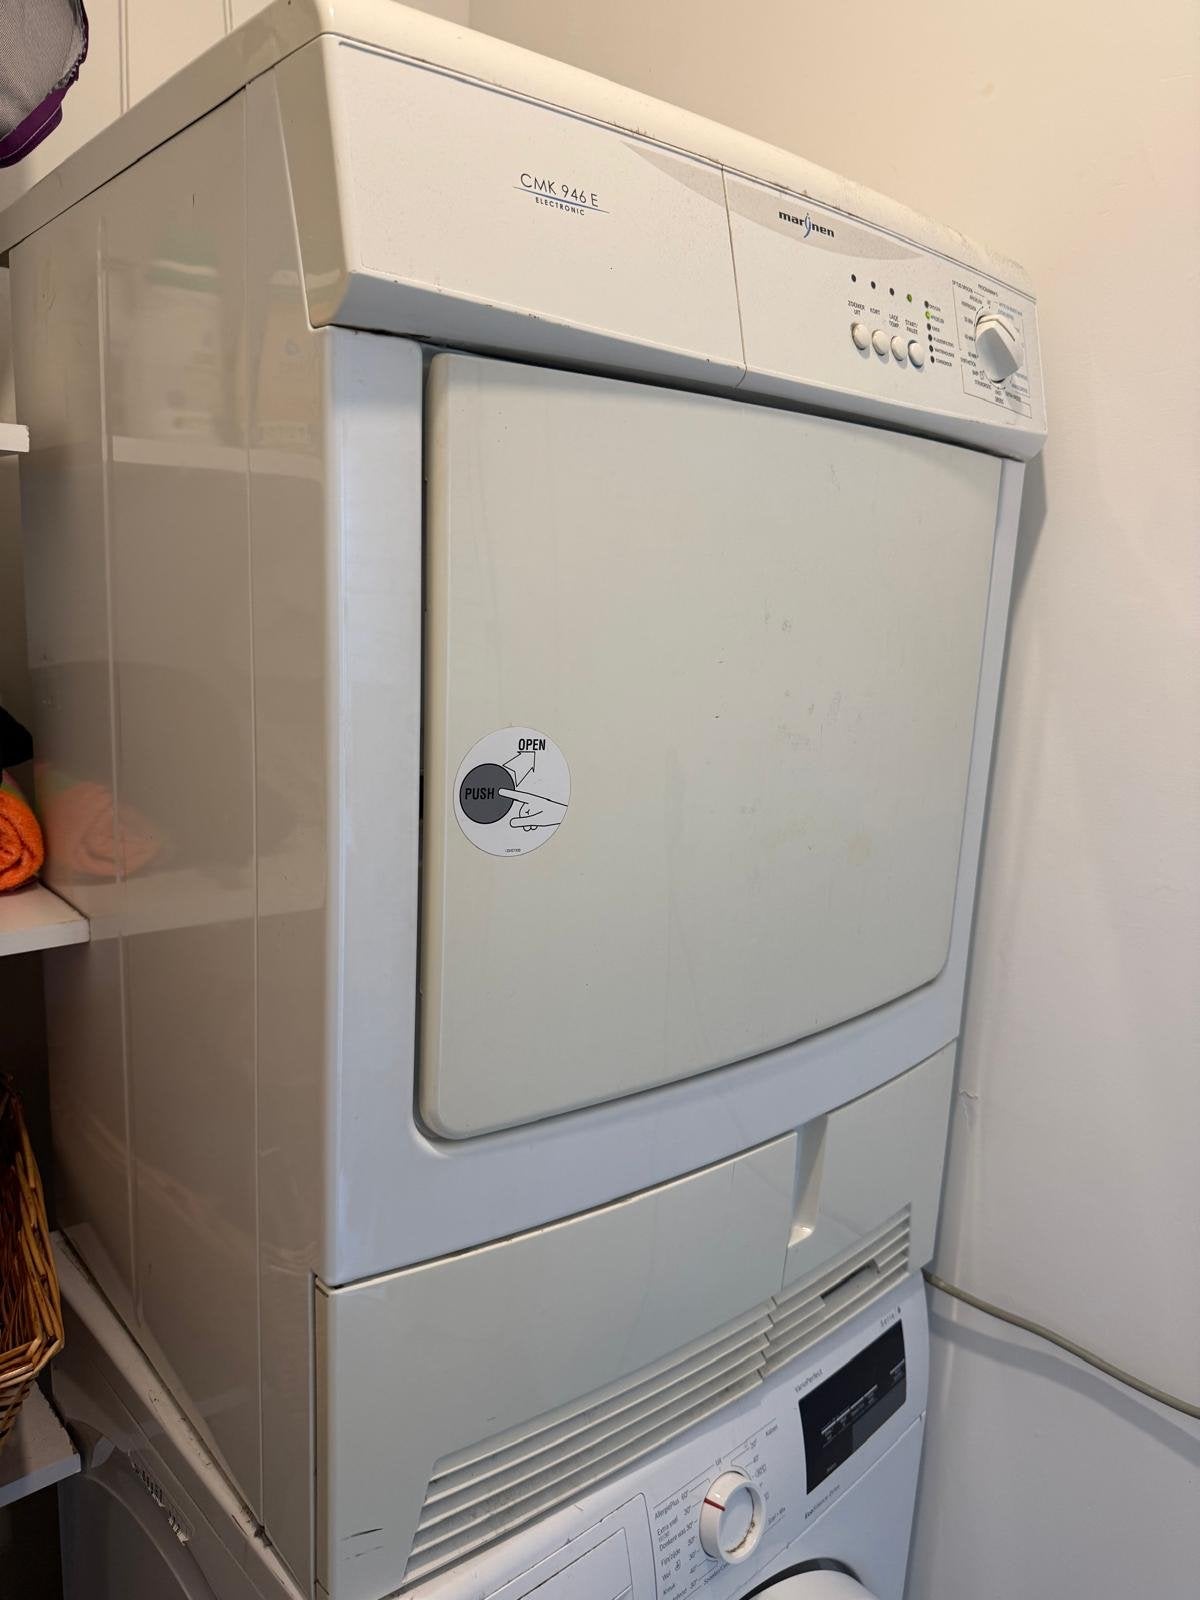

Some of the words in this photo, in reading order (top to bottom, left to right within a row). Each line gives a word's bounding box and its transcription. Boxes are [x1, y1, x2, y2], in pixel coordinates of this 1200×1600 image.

[519, 173, 557, 195] CMK
[561, 184, 587, 204] 946
[590, 192, 599, 207] E
[535, 196, 585, 216] ELECTRONIC
[518, 738, 546, 751] OPEN
[464, 787, 495, 800] PUSH
